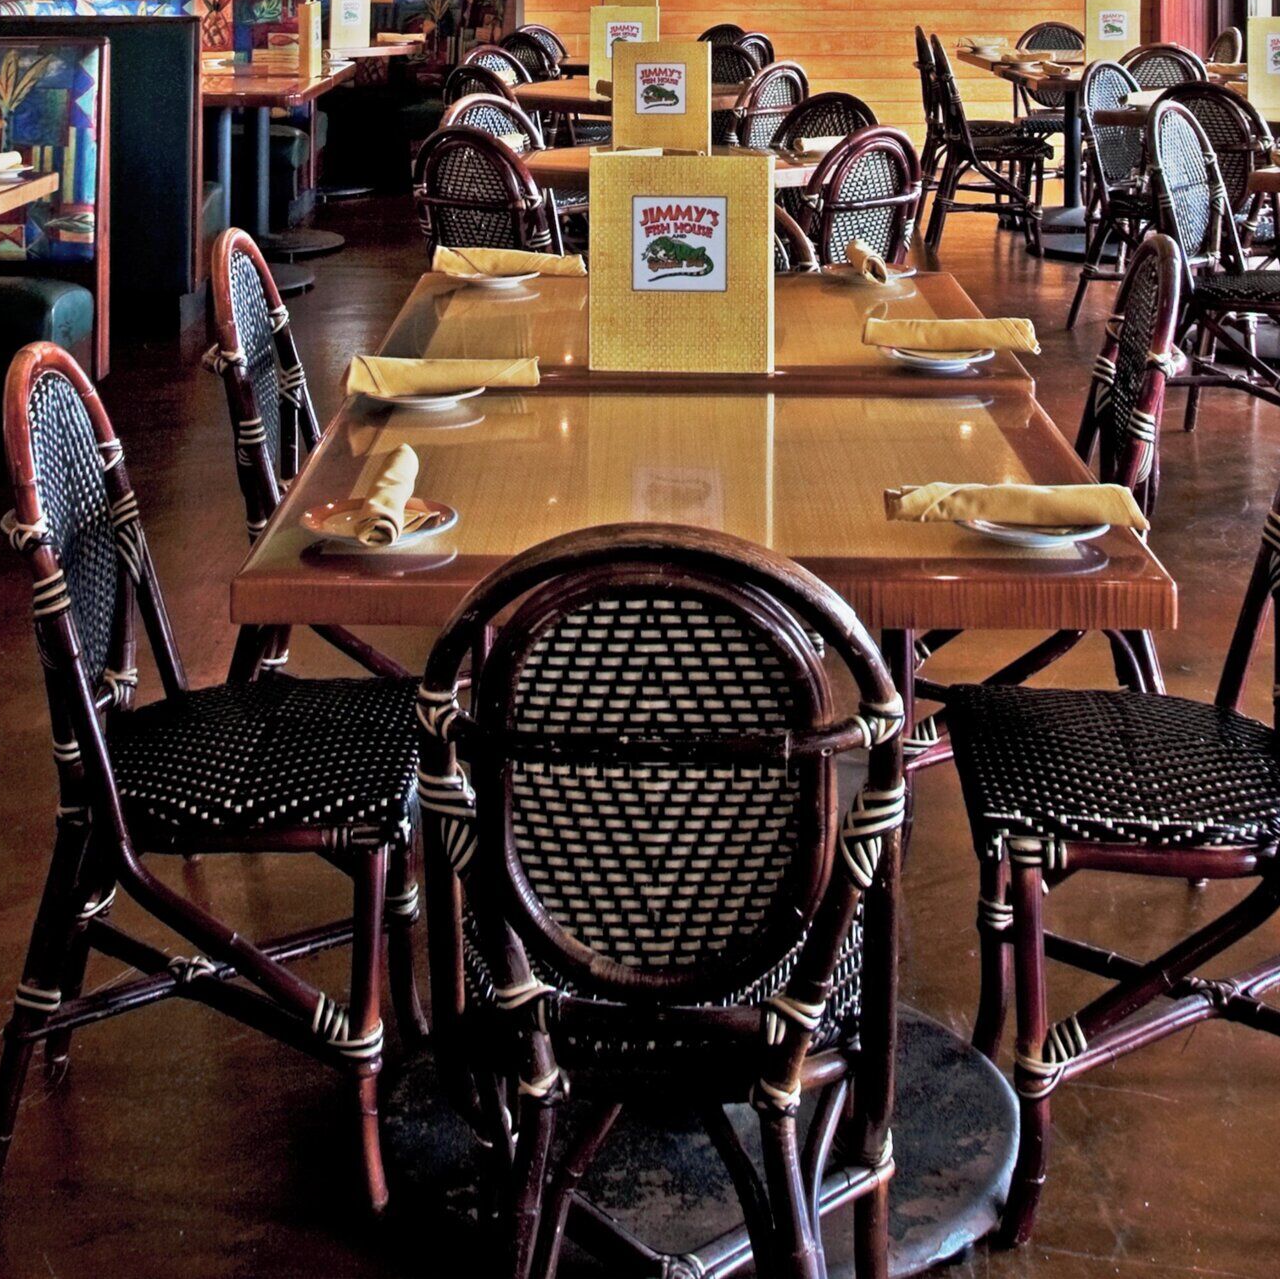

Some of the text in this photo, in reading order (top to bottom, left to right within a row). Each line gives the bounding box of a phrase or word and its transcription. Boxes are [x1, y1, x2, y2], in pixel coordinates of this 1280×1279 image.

[640, 67, 682, 79] JIMMY'S
[640, 204, 720, 227] JIMMY'S
[644, 222, 714, 238] FISH HOUSE
